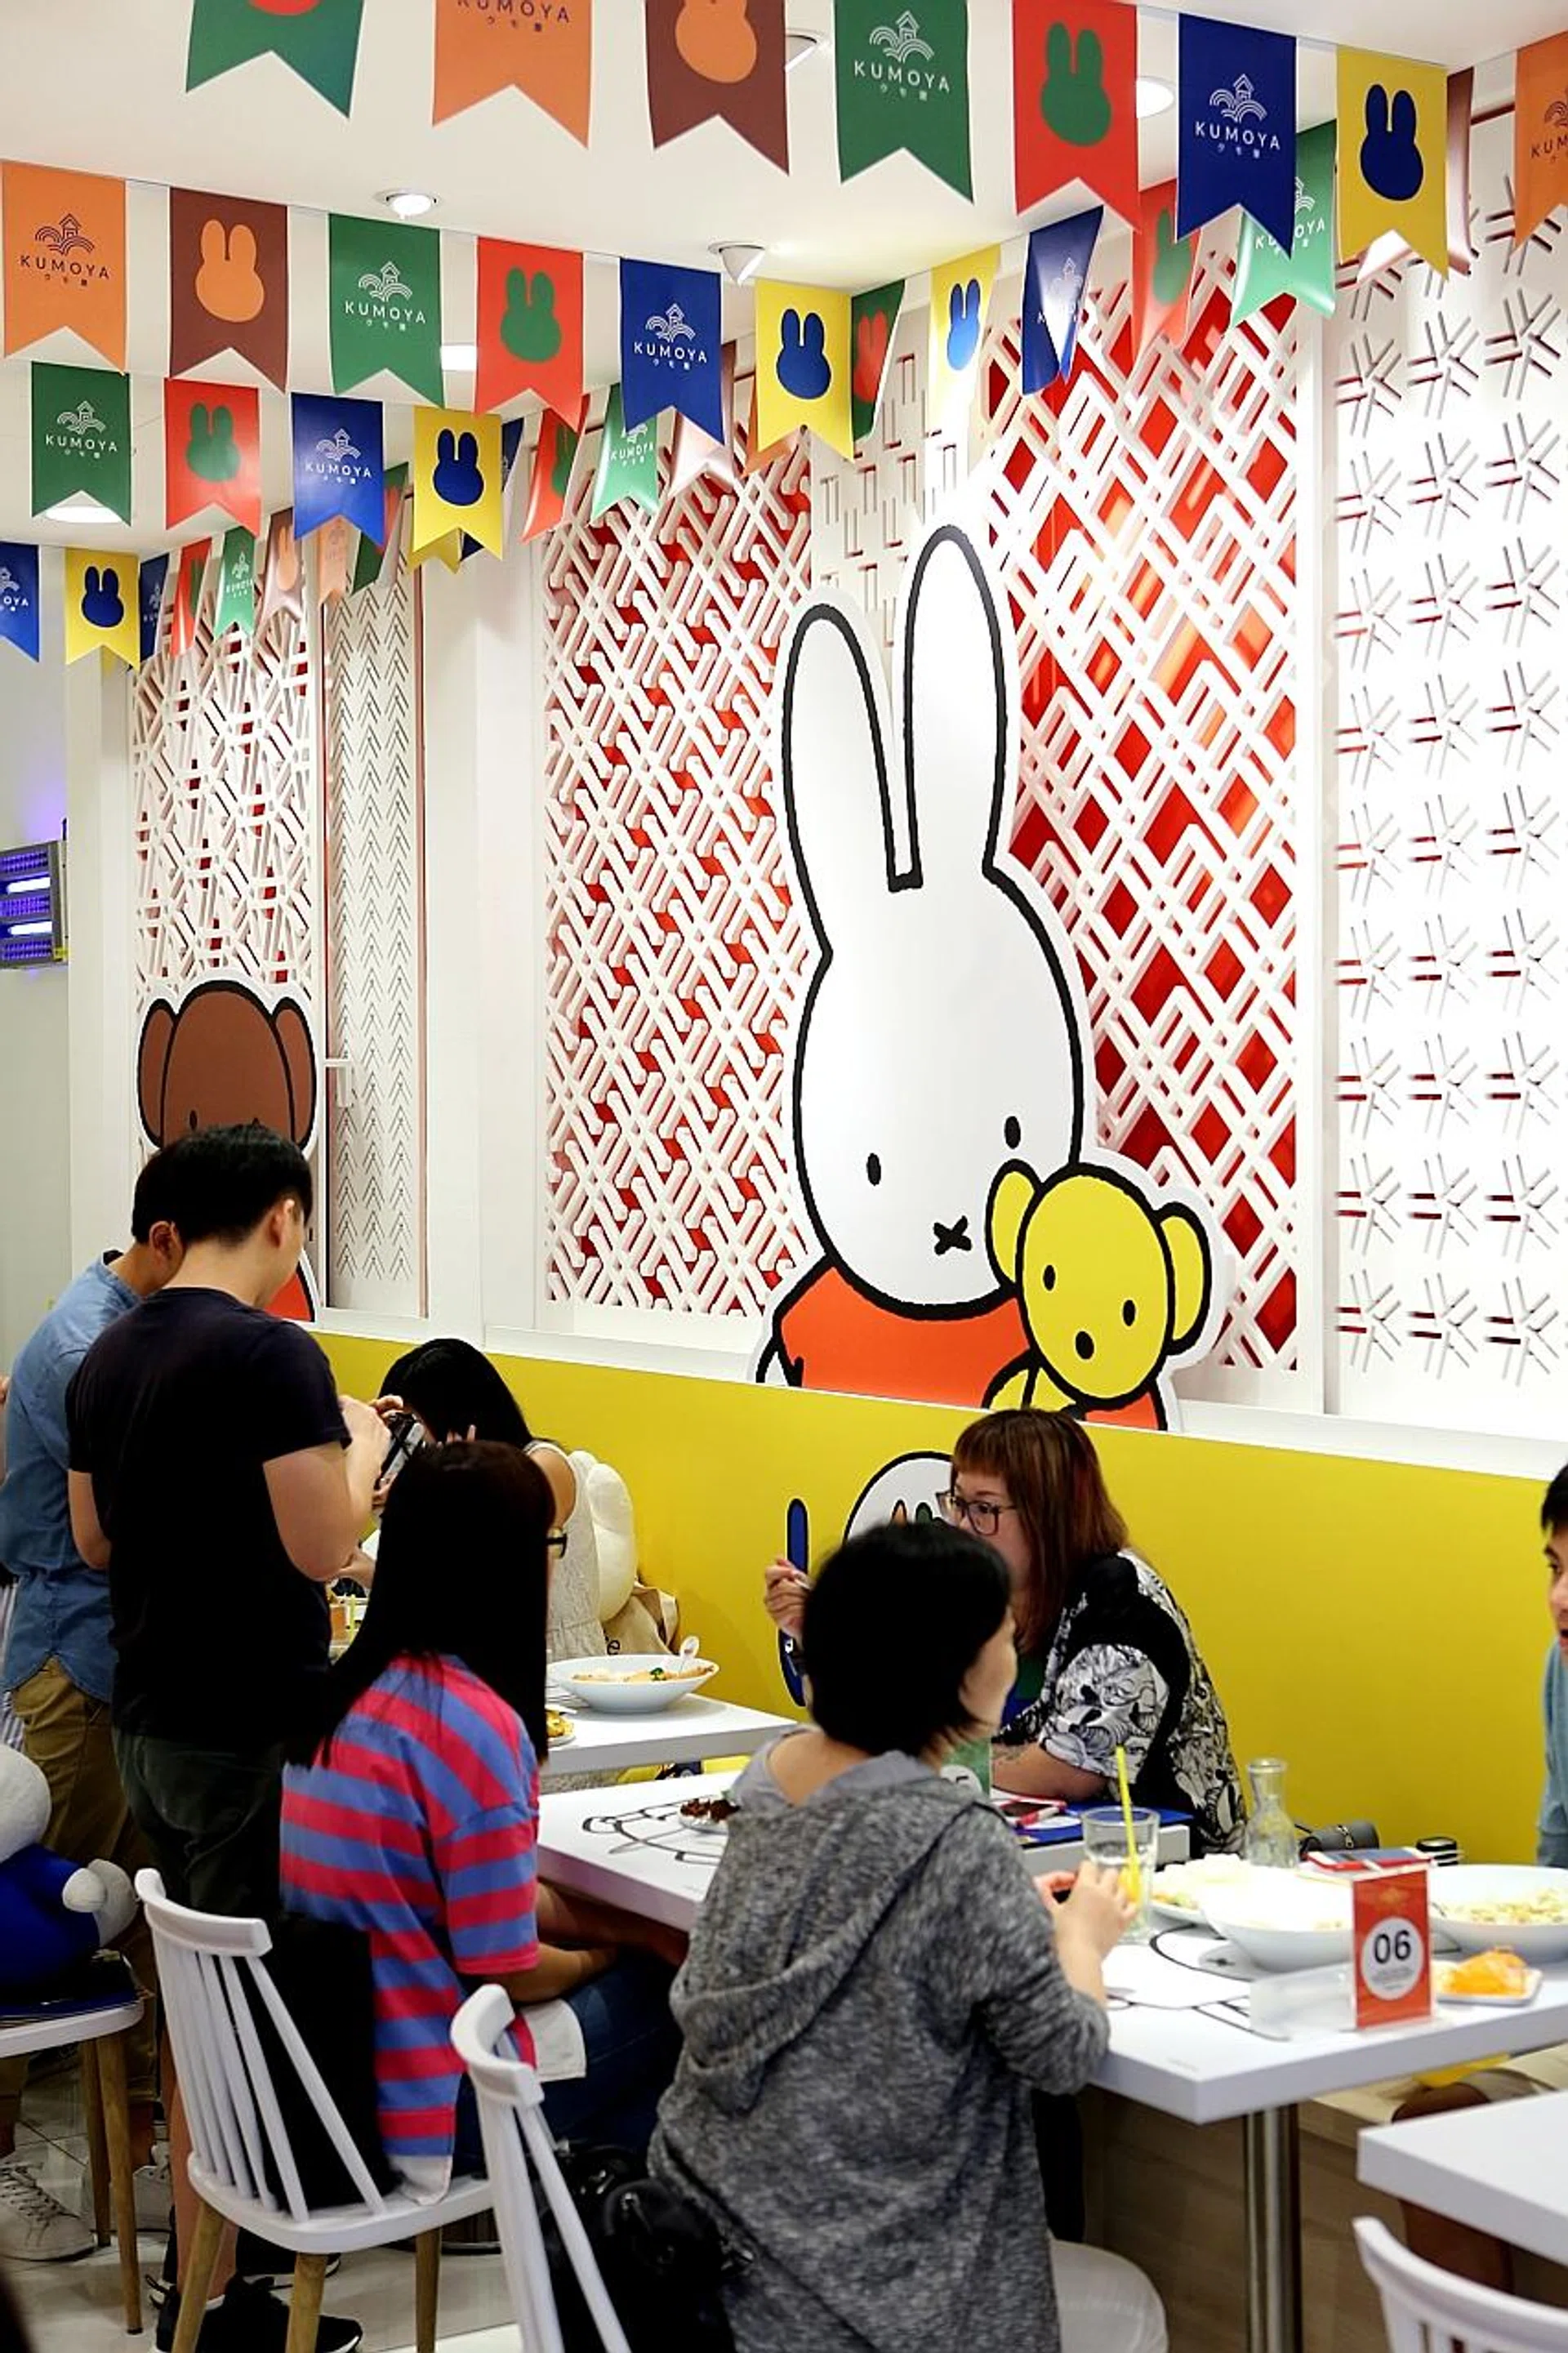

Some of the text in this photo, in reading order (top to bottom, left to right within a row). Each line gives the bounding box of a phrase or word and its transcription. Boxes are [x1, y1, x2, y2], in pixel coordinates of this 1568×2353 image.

[854, 60, 950, 93] KUMOYA
[1195, 122, 1281, 150] KUMOYA
[1255, 217, 1325, 249] KUOYA
[20, 255, 109, 279] KUMOYA
[345, 300, 425, 323] KUMOYA
[634, 341, 706, 363] KUMOYA
[46, 435, 118, 452] KUMOYA
[305, 462, 372, 479] KUMOYA
[1374, 1930, 1411, 1964] 06
